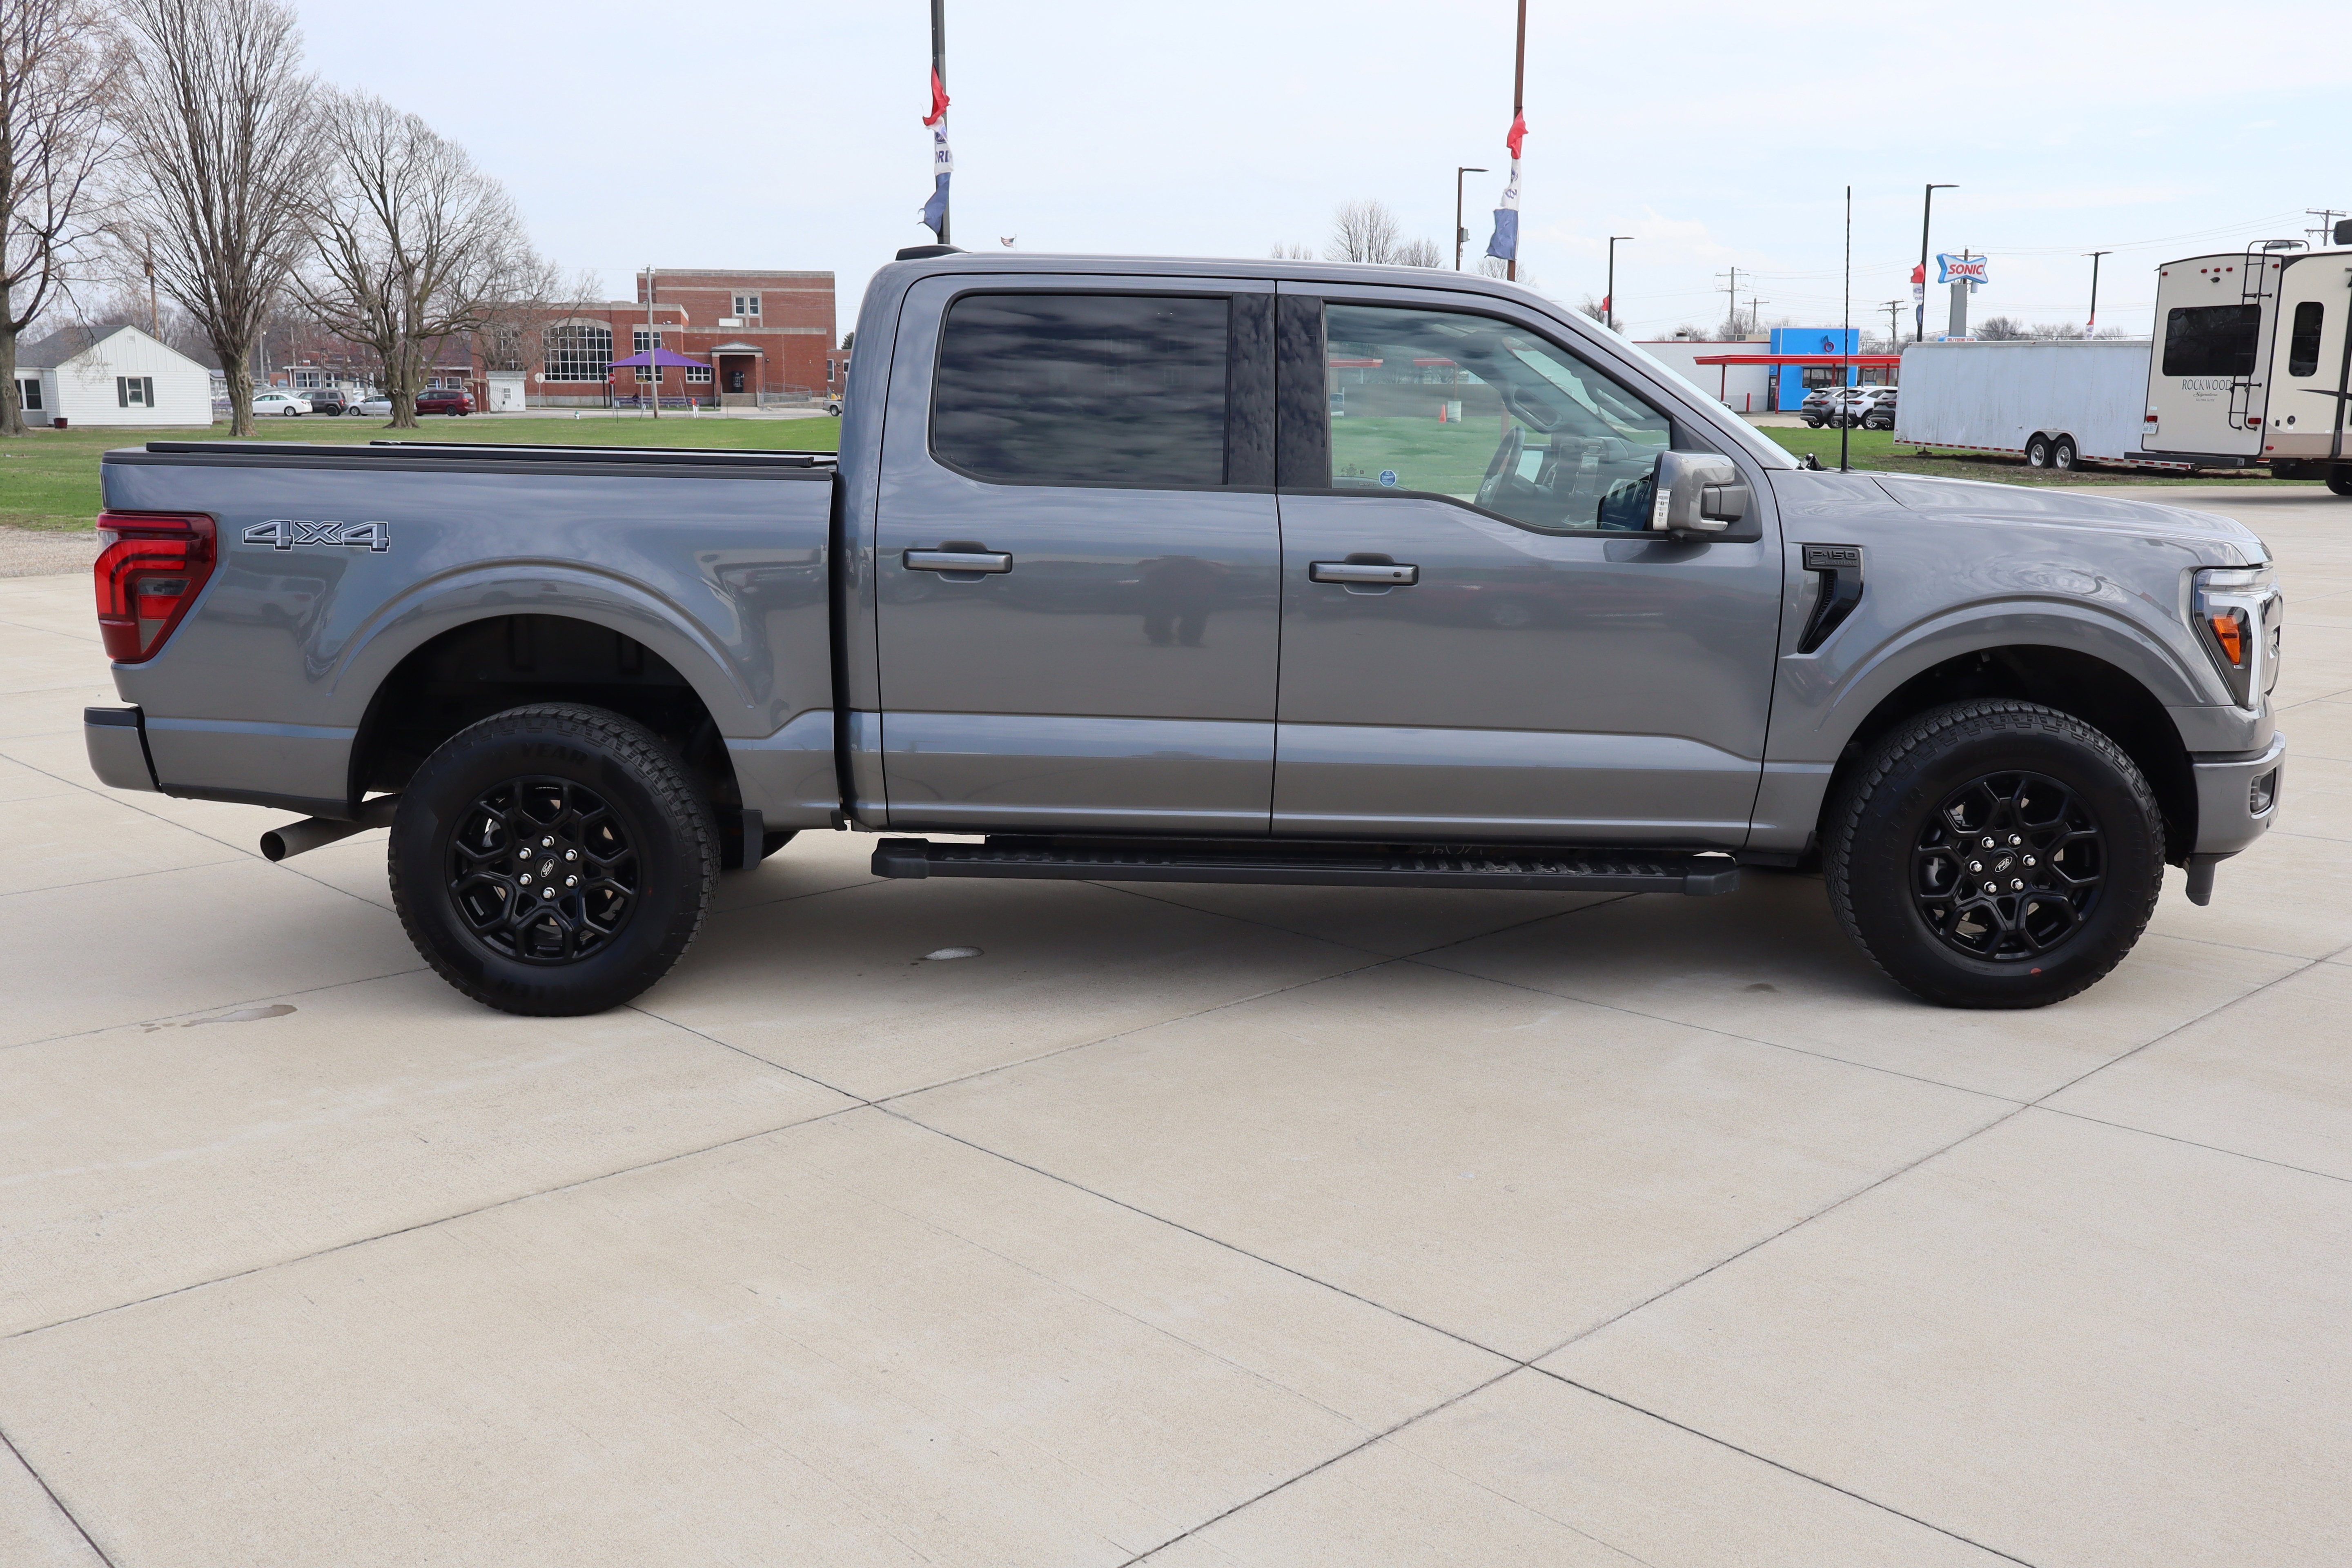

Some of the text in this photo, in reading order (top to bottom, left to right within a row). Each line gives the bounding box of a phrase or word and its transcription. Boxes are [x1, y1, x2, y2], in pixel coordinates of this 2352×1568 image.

[1947, 264, 1984, 274] SONIC
[2182, 379, 2232, 390] ROCKWOOD
[1809, 550, 1858, 559] F-150
[542, 861, 552, 875] Ford
[1997, 858, 2011, 871] Ford
